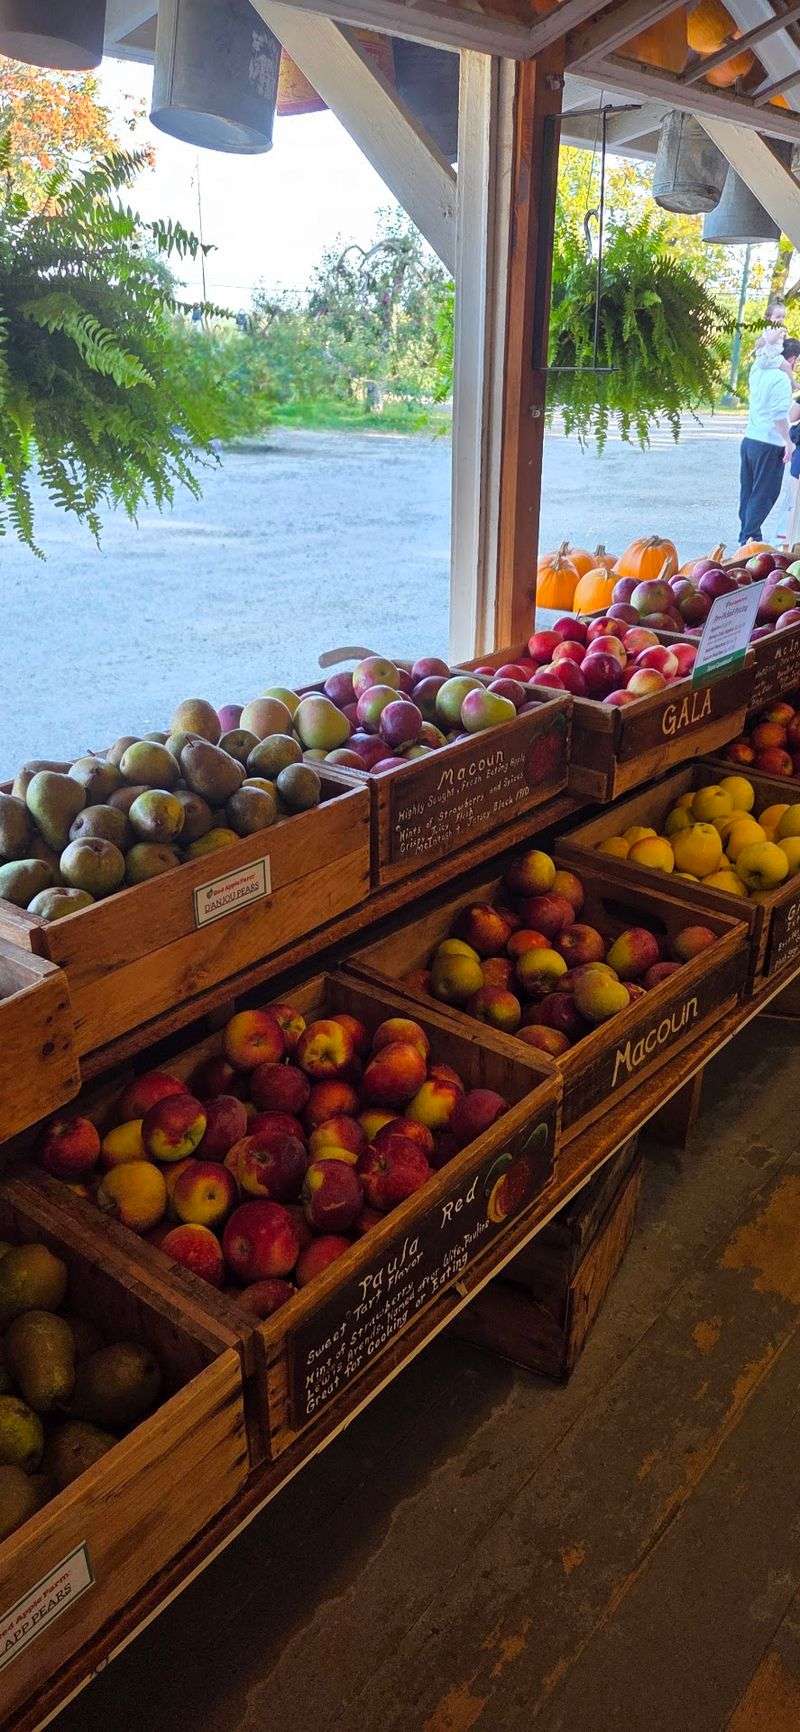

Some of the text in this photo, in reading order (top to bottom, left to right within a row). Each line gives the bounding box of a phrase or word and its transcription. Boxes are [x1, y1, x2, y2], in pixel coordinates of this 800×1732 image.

[662, 688, 712, 735] GALA
[437, 751, 504, 790] Macoun
[398, 801, 426, 822] Highly
[611, 997, 698, 1087] Macoun
[358, 1176, 479, 1301] Paula Red
[306, 1251, 424, 1365] Sweet Tart Flavor
[306, 1252, 468, 1414] Great for Cooking or Eating
[305, 1358, 332, 1389] Hint
[336, 1342, 346, 1360] of
[32, 1583, 71, 1624] PEARS
